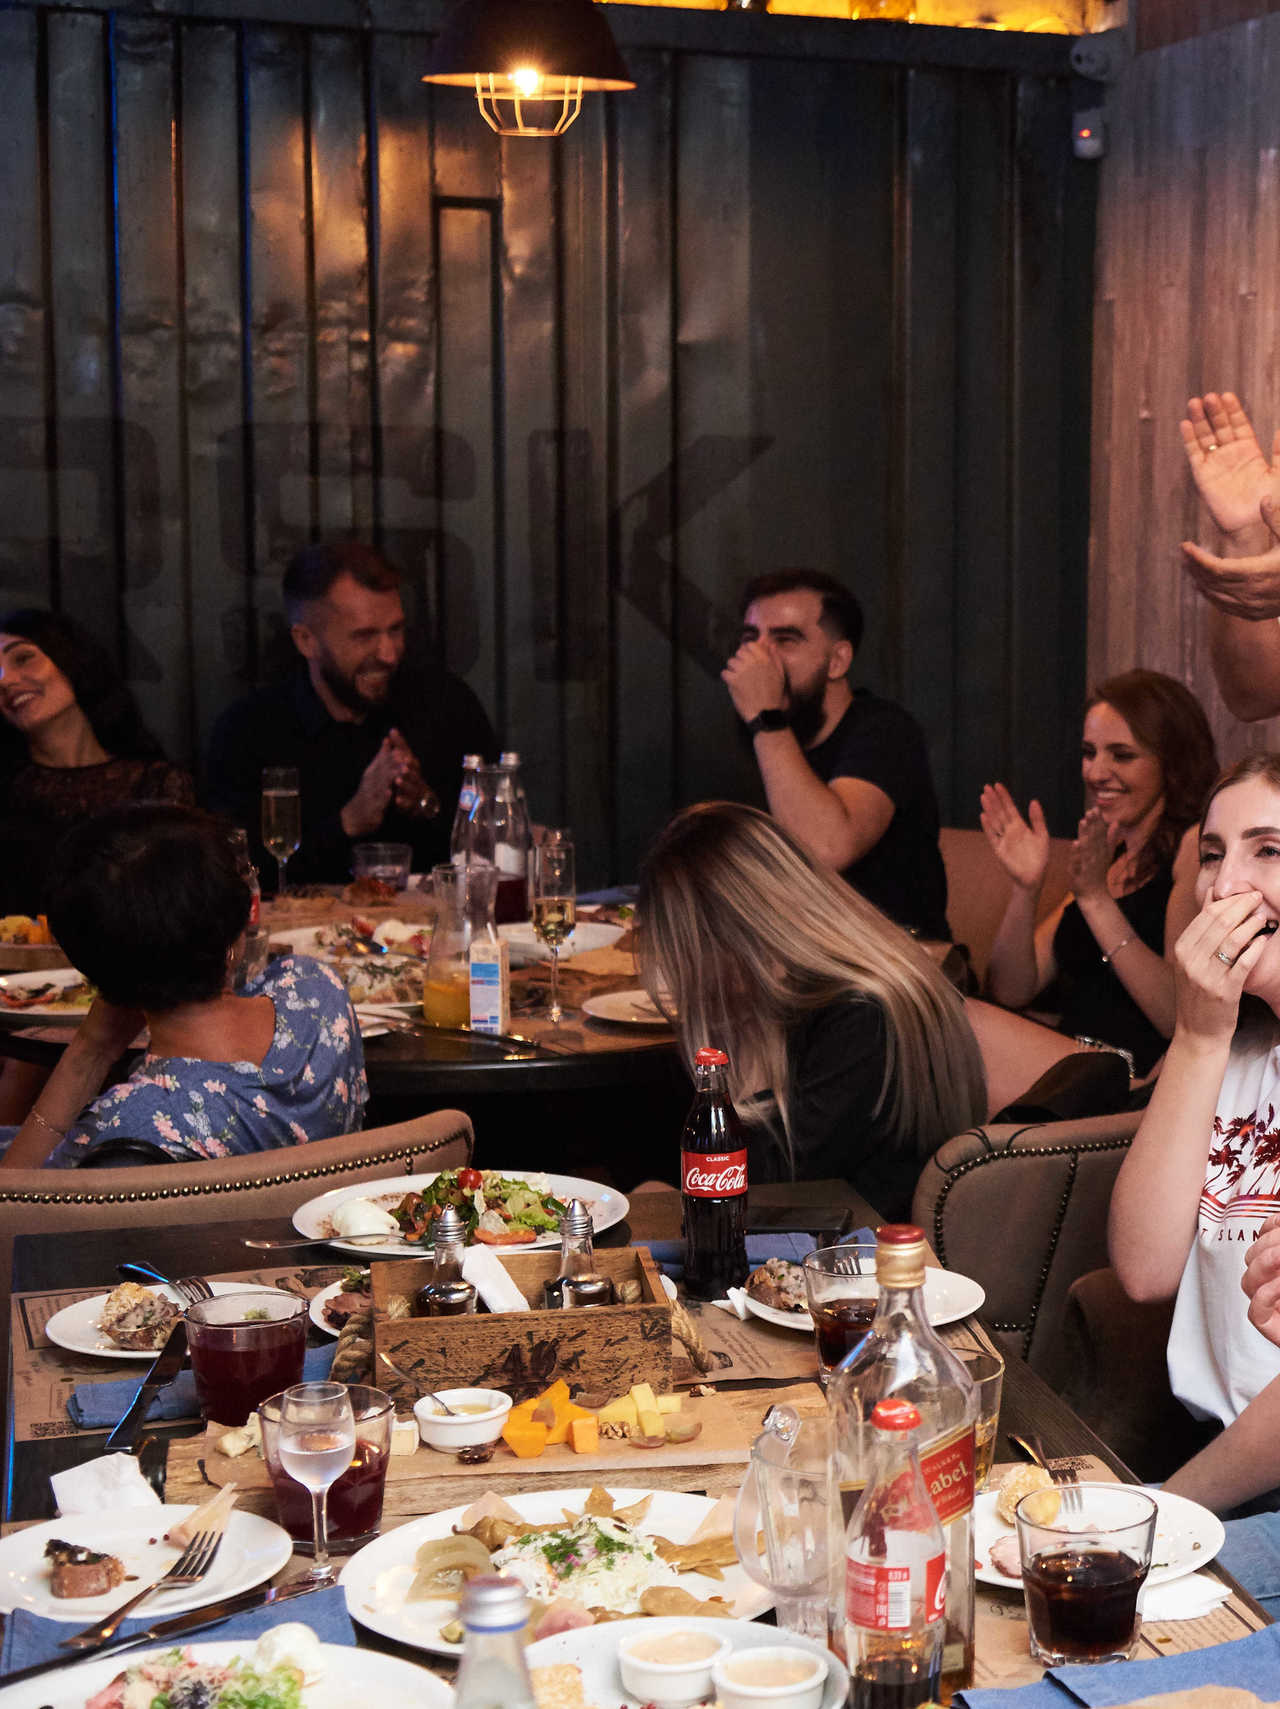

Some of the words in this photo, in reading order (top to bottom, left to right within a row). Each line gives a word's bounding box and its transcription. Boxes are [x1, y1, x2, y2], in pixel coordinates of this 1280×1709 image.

[686, 1163, 746, 1192] Coca-Cola
[1217, 1228, 1261, 1242] SLAN
[929, 1459, 969, 1496] abel
